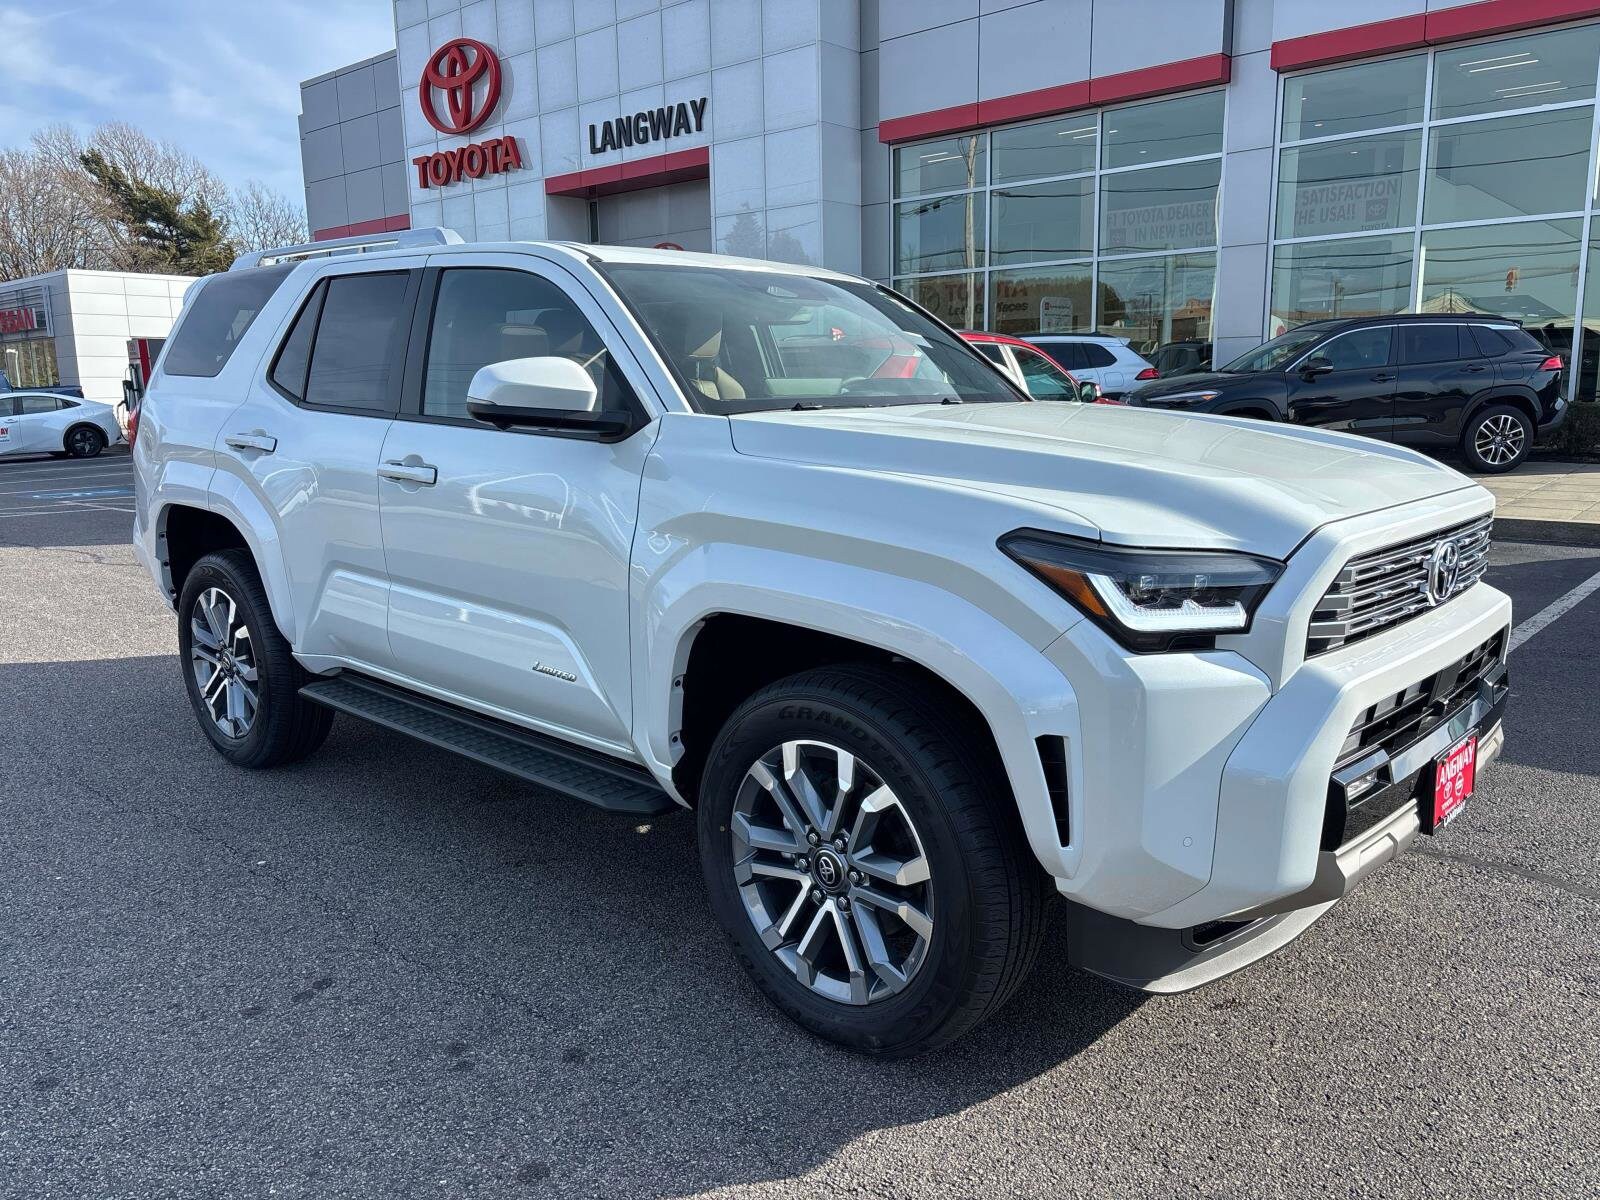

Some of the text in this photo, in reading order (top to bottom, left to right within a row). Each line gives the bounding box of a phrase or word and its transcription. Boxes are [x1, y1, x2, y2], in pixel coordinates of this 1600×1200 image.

[589, 97, 708, 155] LANGWAY
[413, 135, 522, 189] TOYOTA
[1302, 178, 1399, 207] SATISFACTION
[1122, 209, 1166, 227] TOYOTA
[1167, 202, 1210, 221] DEALER
[1135, 227, 1147, 242] IN
[1149, 223, 1176, 241] NEW
[1435, 741, 1475, 792] LANGWAY
